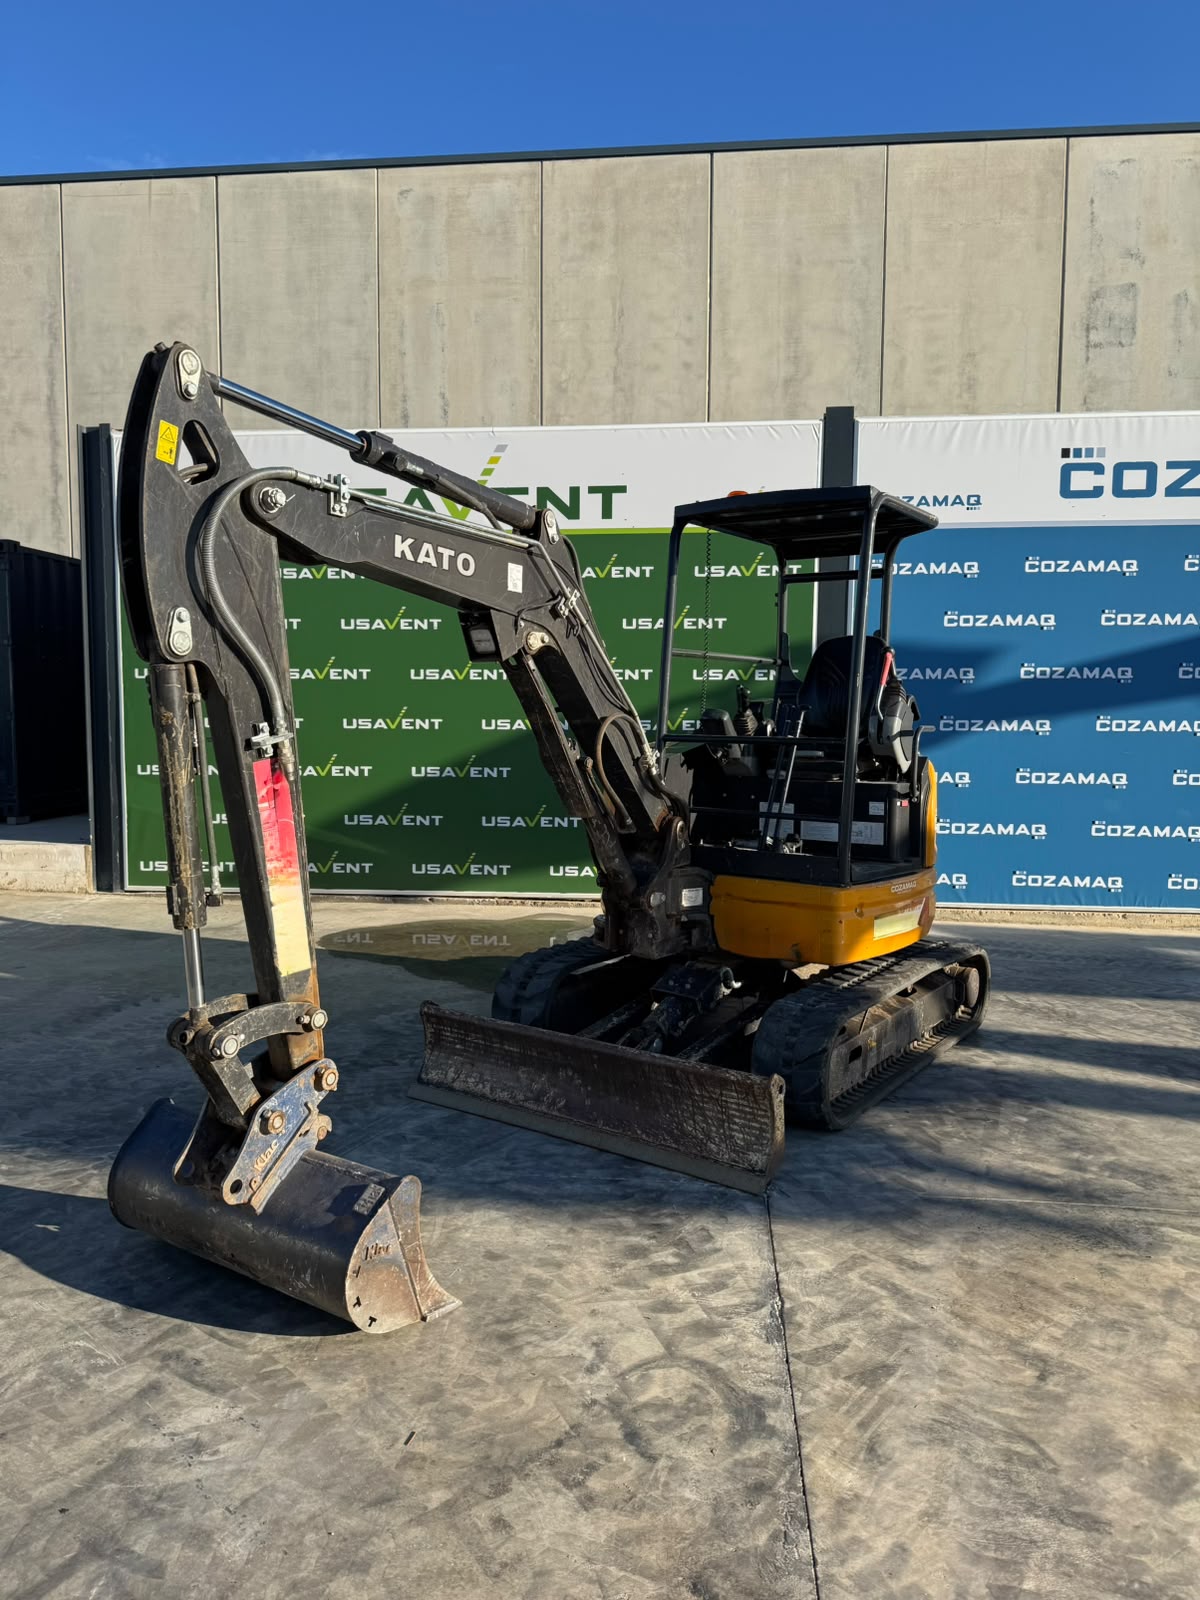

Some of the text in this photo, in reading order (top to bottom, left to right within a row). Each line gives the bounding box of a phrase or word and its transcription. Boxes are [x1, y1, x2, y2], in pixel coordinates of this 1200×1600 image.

[393, 534, 476, 577] KATO
[280, 565, 365, 579] SAVEN
[582, 562, 654, 579] AVENT
[1024, 560, 1139, 573] COZAMAQ
[340, 615, 442, 630] USAVENT
[943, 614, 1056, 627] COZAMAQ
[289, 665, 371, 680] SAVENT
[896, 667, 975, 680] ZAMAQ
[1020, 666, 1133, 679] COZAMAQ
[342, 715, 442, 730] USAVENT
[939, 719, 1052, 732] COZAMAQ
[411, 763, 511, 778] USAVENT
[1015, 772, 1128, 785] COZAMAQ
[344, 811, 443, 826] USAVENT
[481, 812, 582, 827] USAVENT
[936, 822, 1047, 836] COZAMAQ
[308, 859, 373, 874] AVENT
[412, 860, 511, 875] USAVENT
[1012, 874, 1124, 888] COZAMAQ
